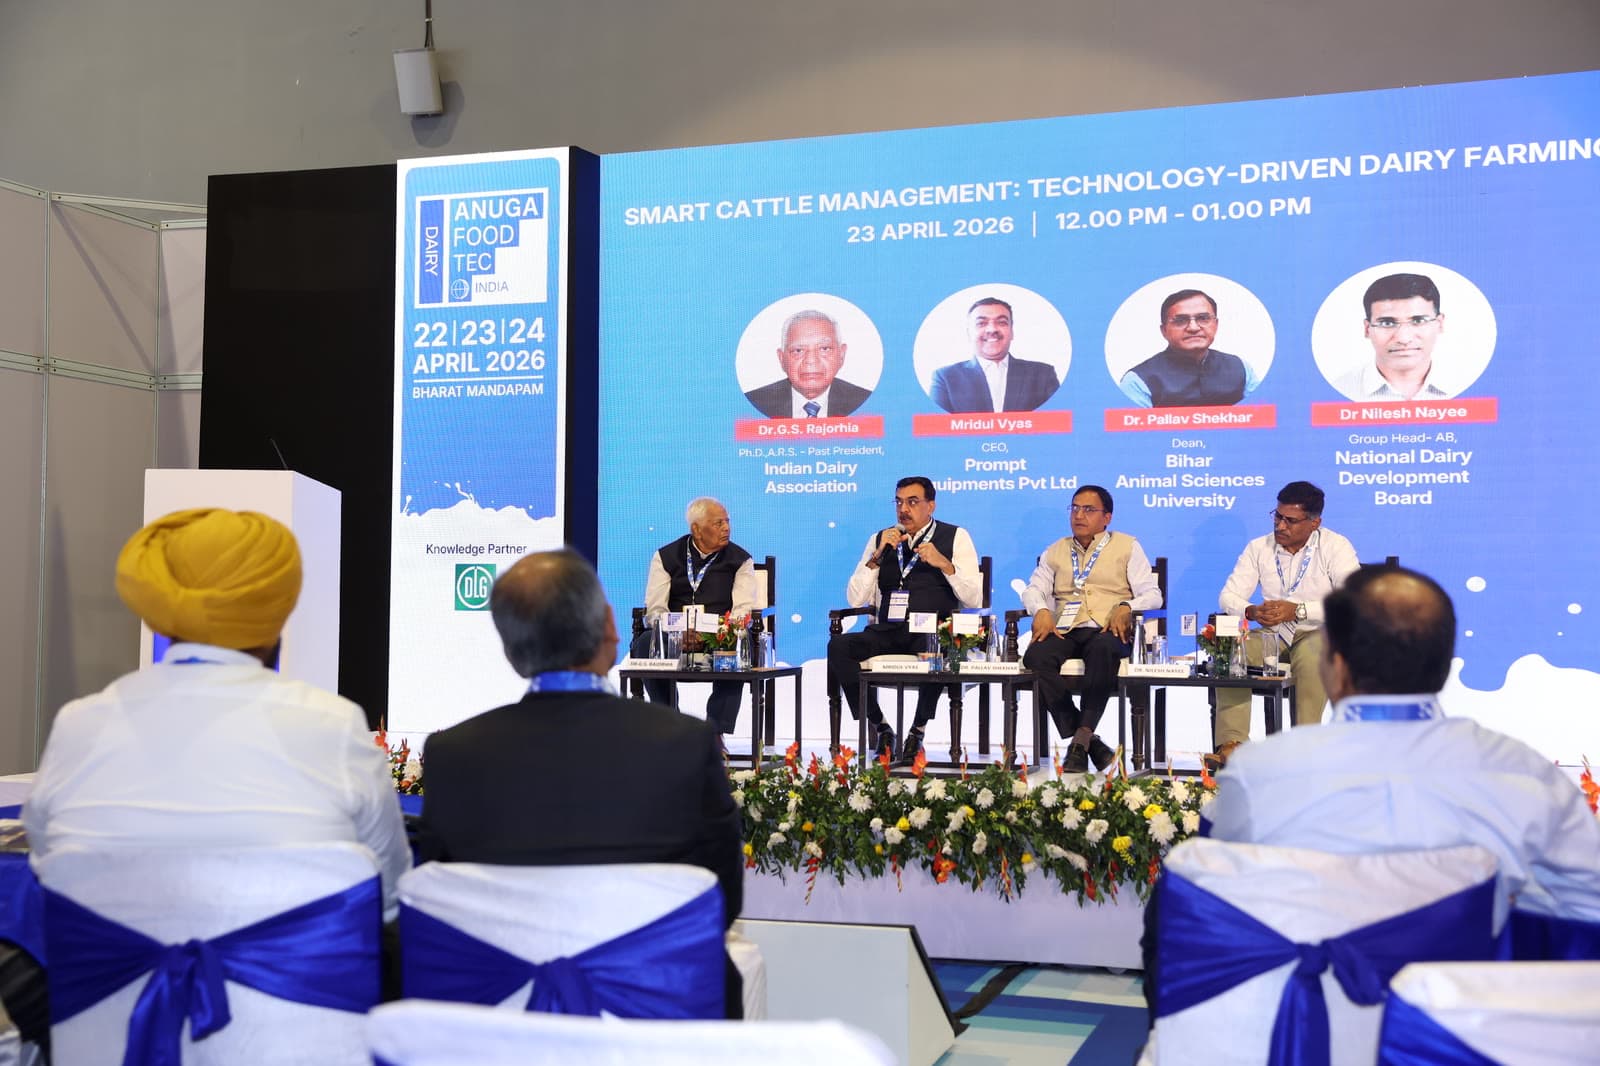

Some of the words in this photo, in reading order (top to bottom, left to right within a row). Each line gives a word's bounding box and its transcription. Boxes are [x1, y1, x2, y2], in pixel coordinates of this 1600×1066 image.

[624, 202, 710, 226] SMART
[715, 195, 812, 220] CATTLE
[818, 181, 1021, 213] MANAGEMENT:
[1028, 156, 1352, 196] TECHNOLOGY-DRIVEN
[1360, 148, 1456, 176] DAIRY
[454, 197, 538, 220] ANUGA
[847, 226, 875, 243] 23
[881, 220, 948, 240] APRIL
[953, 216, 1014, 237] 2026
[1056, 207, 1122, 230] 12.00
[1128, 206, 1168, 225] PM
[1191, 200, 1263, 221] 01.00
[1269, 197, 1312, 216] PM
[454, 225, 514, 247] FOOD
[425, 226, 439, 277] DAIRY
[454, 252, 492, 273] TEC
[475, 281, 509, 293] INDIA
[413, 353, 480, 375] APRIL
[486, 350, 545, 371] 2026
[412, 386, 464, 399] BHARAT
[466, 383, 544, 397] MANDAPAM
[1123, 414, 1144, 426] Dr.
[1147, 413, 1190, 426] Pallav
[1192, 412, 1253, 425] Shekhar
[1340, 408, 1359, 420] Dr
[1362, 407, 1412, 419] Nilesh
[1415, 407, 1468, 420] Nayee
[758, 424, 803, 436] Dr.G.S.
[806, 423, 859, 435] Rajorhia
[951, 419, 994, 431] Mridul
[998, 419, 1033, 431] Vyas
[1172, 438, 1206, 449] Dean,
[1349, 434, 1388, 445] Group
[1391, 432, 1432, 443] Head-
[1435, 432, 1458, 444] AB,
[808, 447, 830, 456] Past
[833, 445, 885, 456] President,
[981, 442, 1009, 453] CEO,
[964, 457, 1027, 474] Prompt
[1165, 454, 1213, 468] Bihar
[1335, 449, 1415, 465] National
[1420, 449, 1473, 466] Dairy
[764, 461, 812, 476] Indian
[815, 460, 858, 476] Dairy
[764, 479, 858, 494] Association
[930, 477, 1015, 494] uipments
[1018, 475, 1047, 491] Pvt
[1050, 475, 1077, 490] Ltd
[1115, 474, 1177, 489] Animal
[1181, 472, 1265, 487] Sciences
[1339, 470, 1470, 487] Development
[1143, 493, 1236, 510] University
[1374, 490, 1433, 505] Board
[425, 543, 485, 556] Knowledge
[487, 543, 528, 554] Partner
[464, 567, 488, 598] DLG
